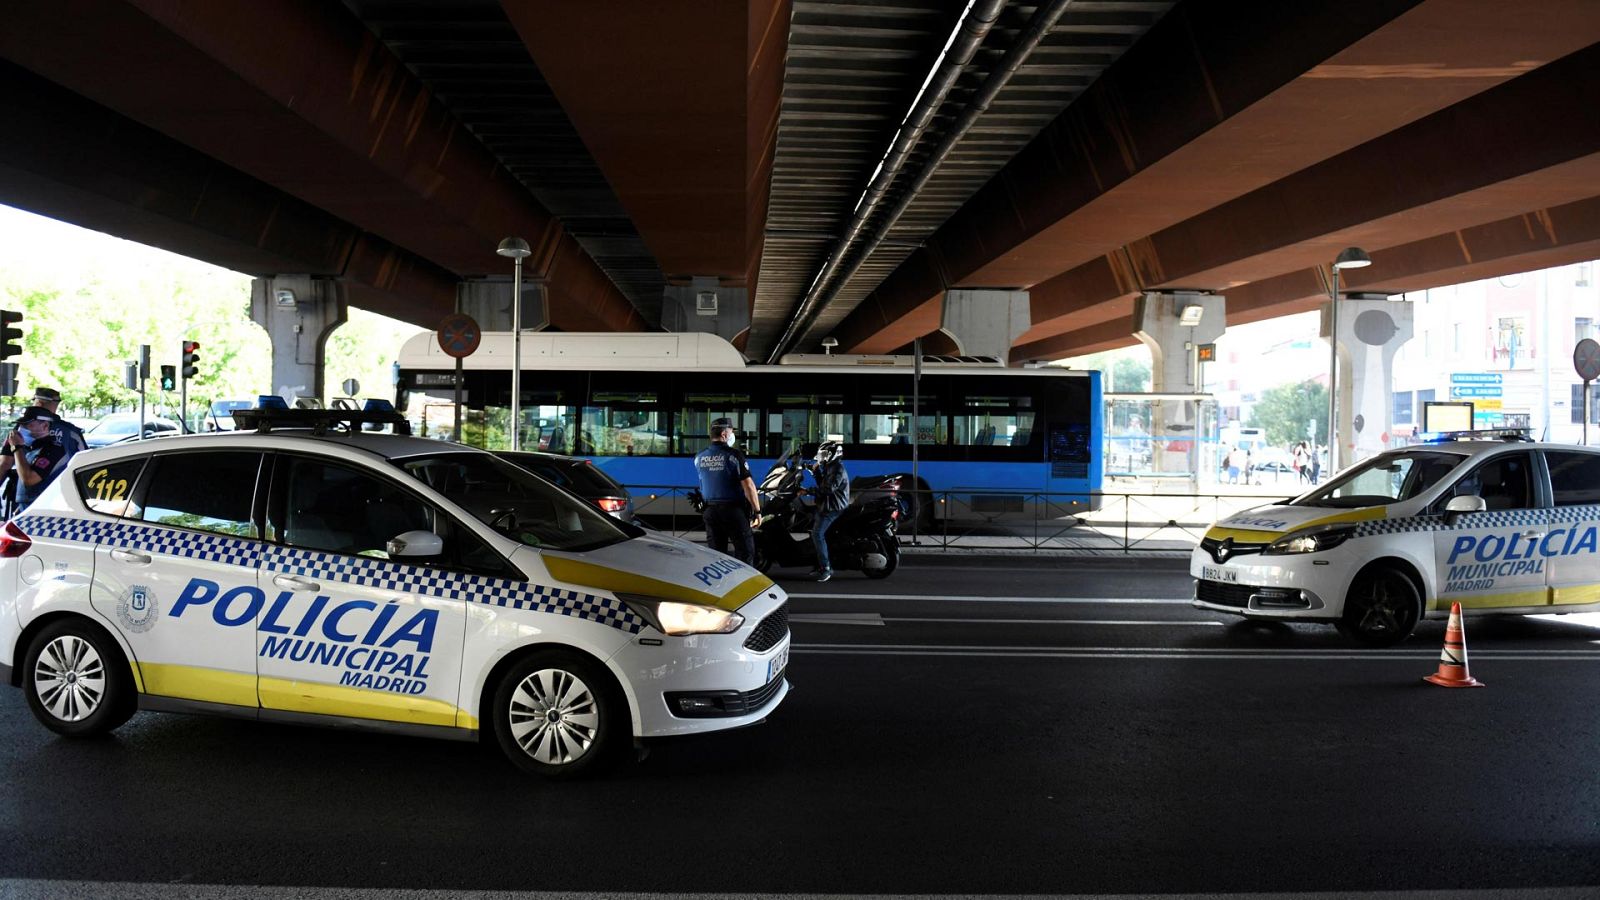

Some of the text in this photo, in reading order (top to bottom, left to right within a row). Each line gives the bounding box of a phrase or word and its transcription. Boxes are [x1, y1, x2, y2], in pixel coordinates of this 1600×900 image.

[700, 453, 725, 462] POLICÍA
[96, 479, 127, 501] 112
[1447, 522, 1597, 565] POLICÍA
[1446, 558, 1543, 581] MUNICIPAL
[1444, 578, 1495, 593] MADRID
[168, 577, 440, 654] POLICÍA
[258, 635, 430, 679] MUNICIPAL
[339, 670, 427, 695] MADRID
